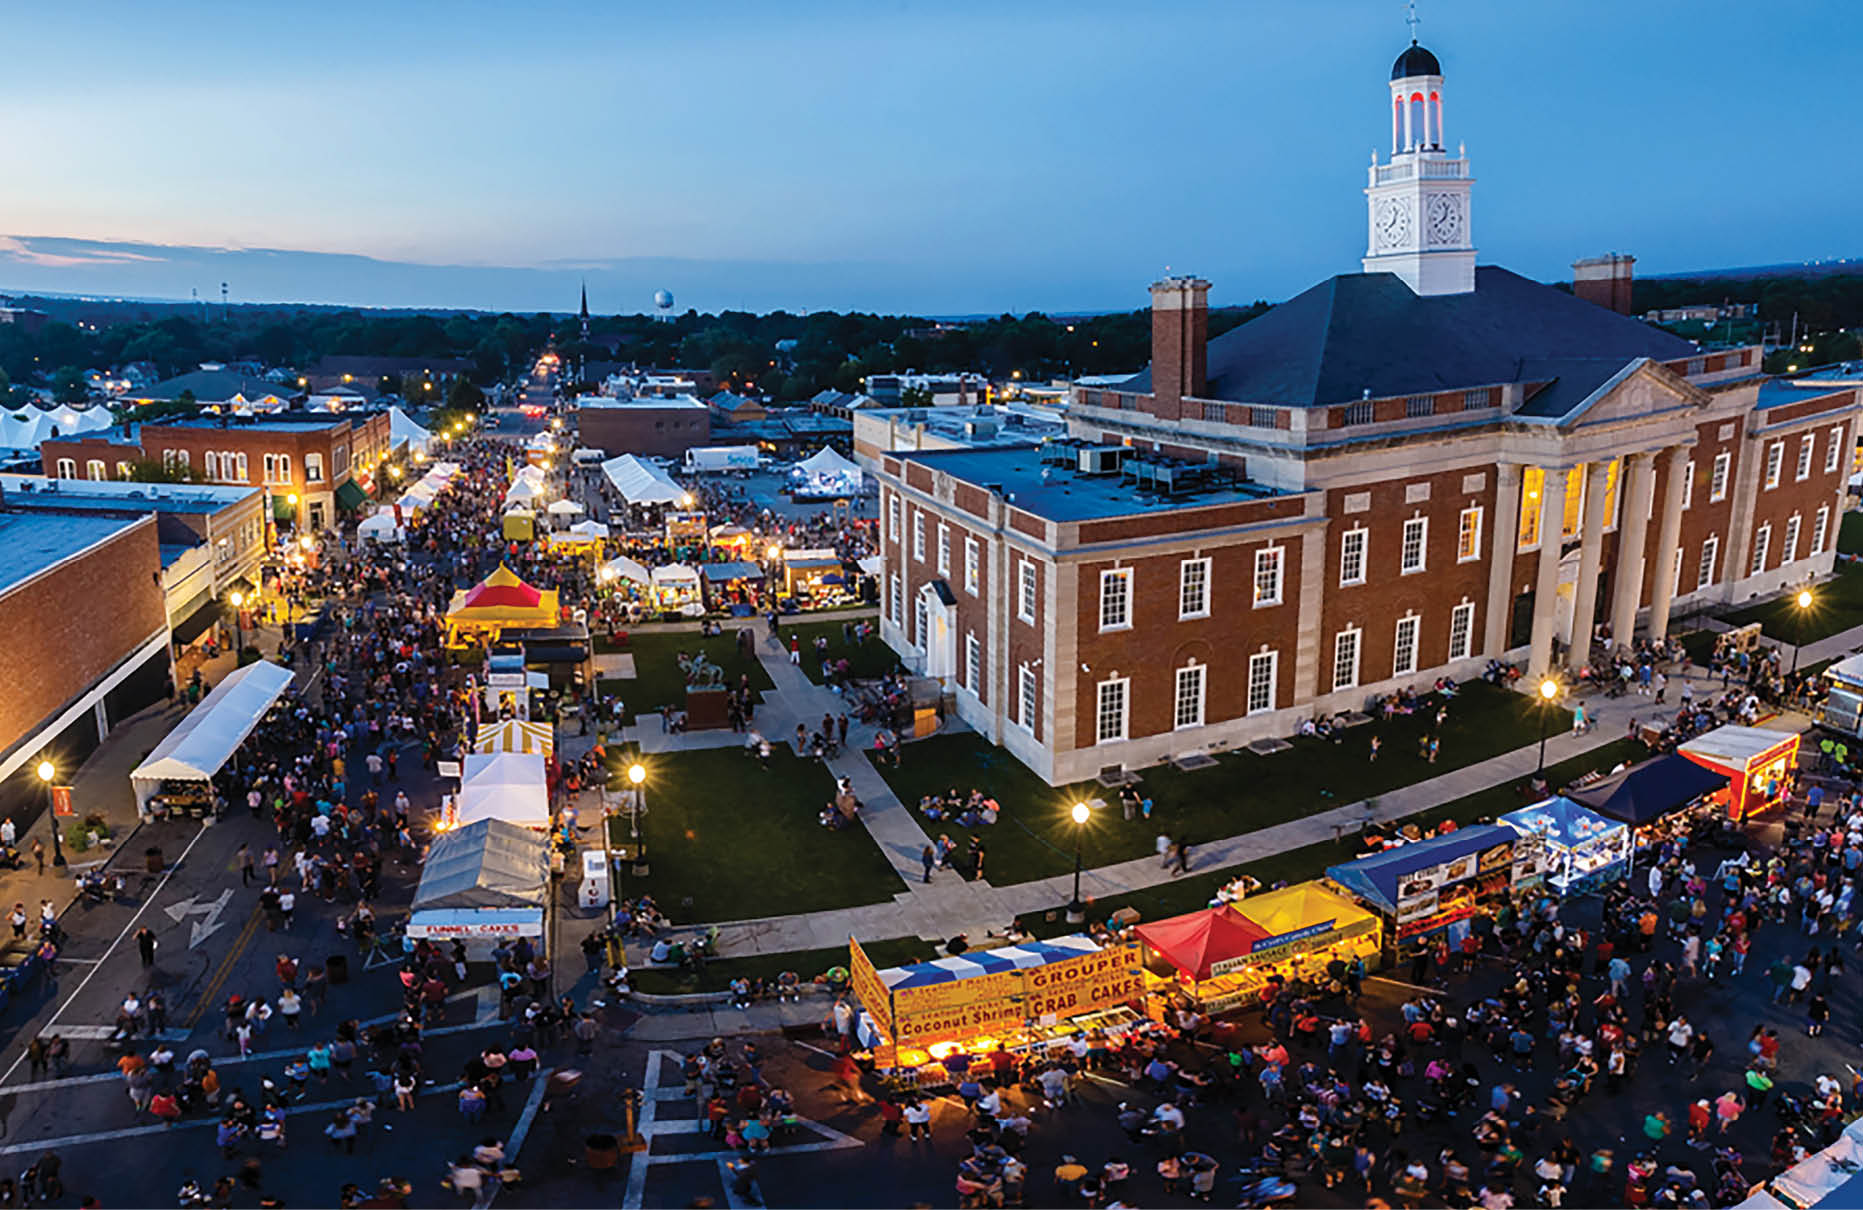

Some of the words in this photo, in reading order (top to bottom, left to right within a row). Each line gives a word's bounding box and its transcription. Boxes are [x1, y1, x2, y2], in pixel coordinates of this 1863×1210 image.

[426, 925, 472, 934] FUNNEL
[480, 924, 519, 933] CAKES
[1033, 952, 1136, 986] GROUPER
[1212, 957, 1249, 973] ITALIAN
[1034, 993, 1077, 1015] CRAB
[1091, 977, 1142, 1002] CAKES
[902, 1014, 967, 1035] Coconut
[972, 1005, 1022, 1025] Shrimp
